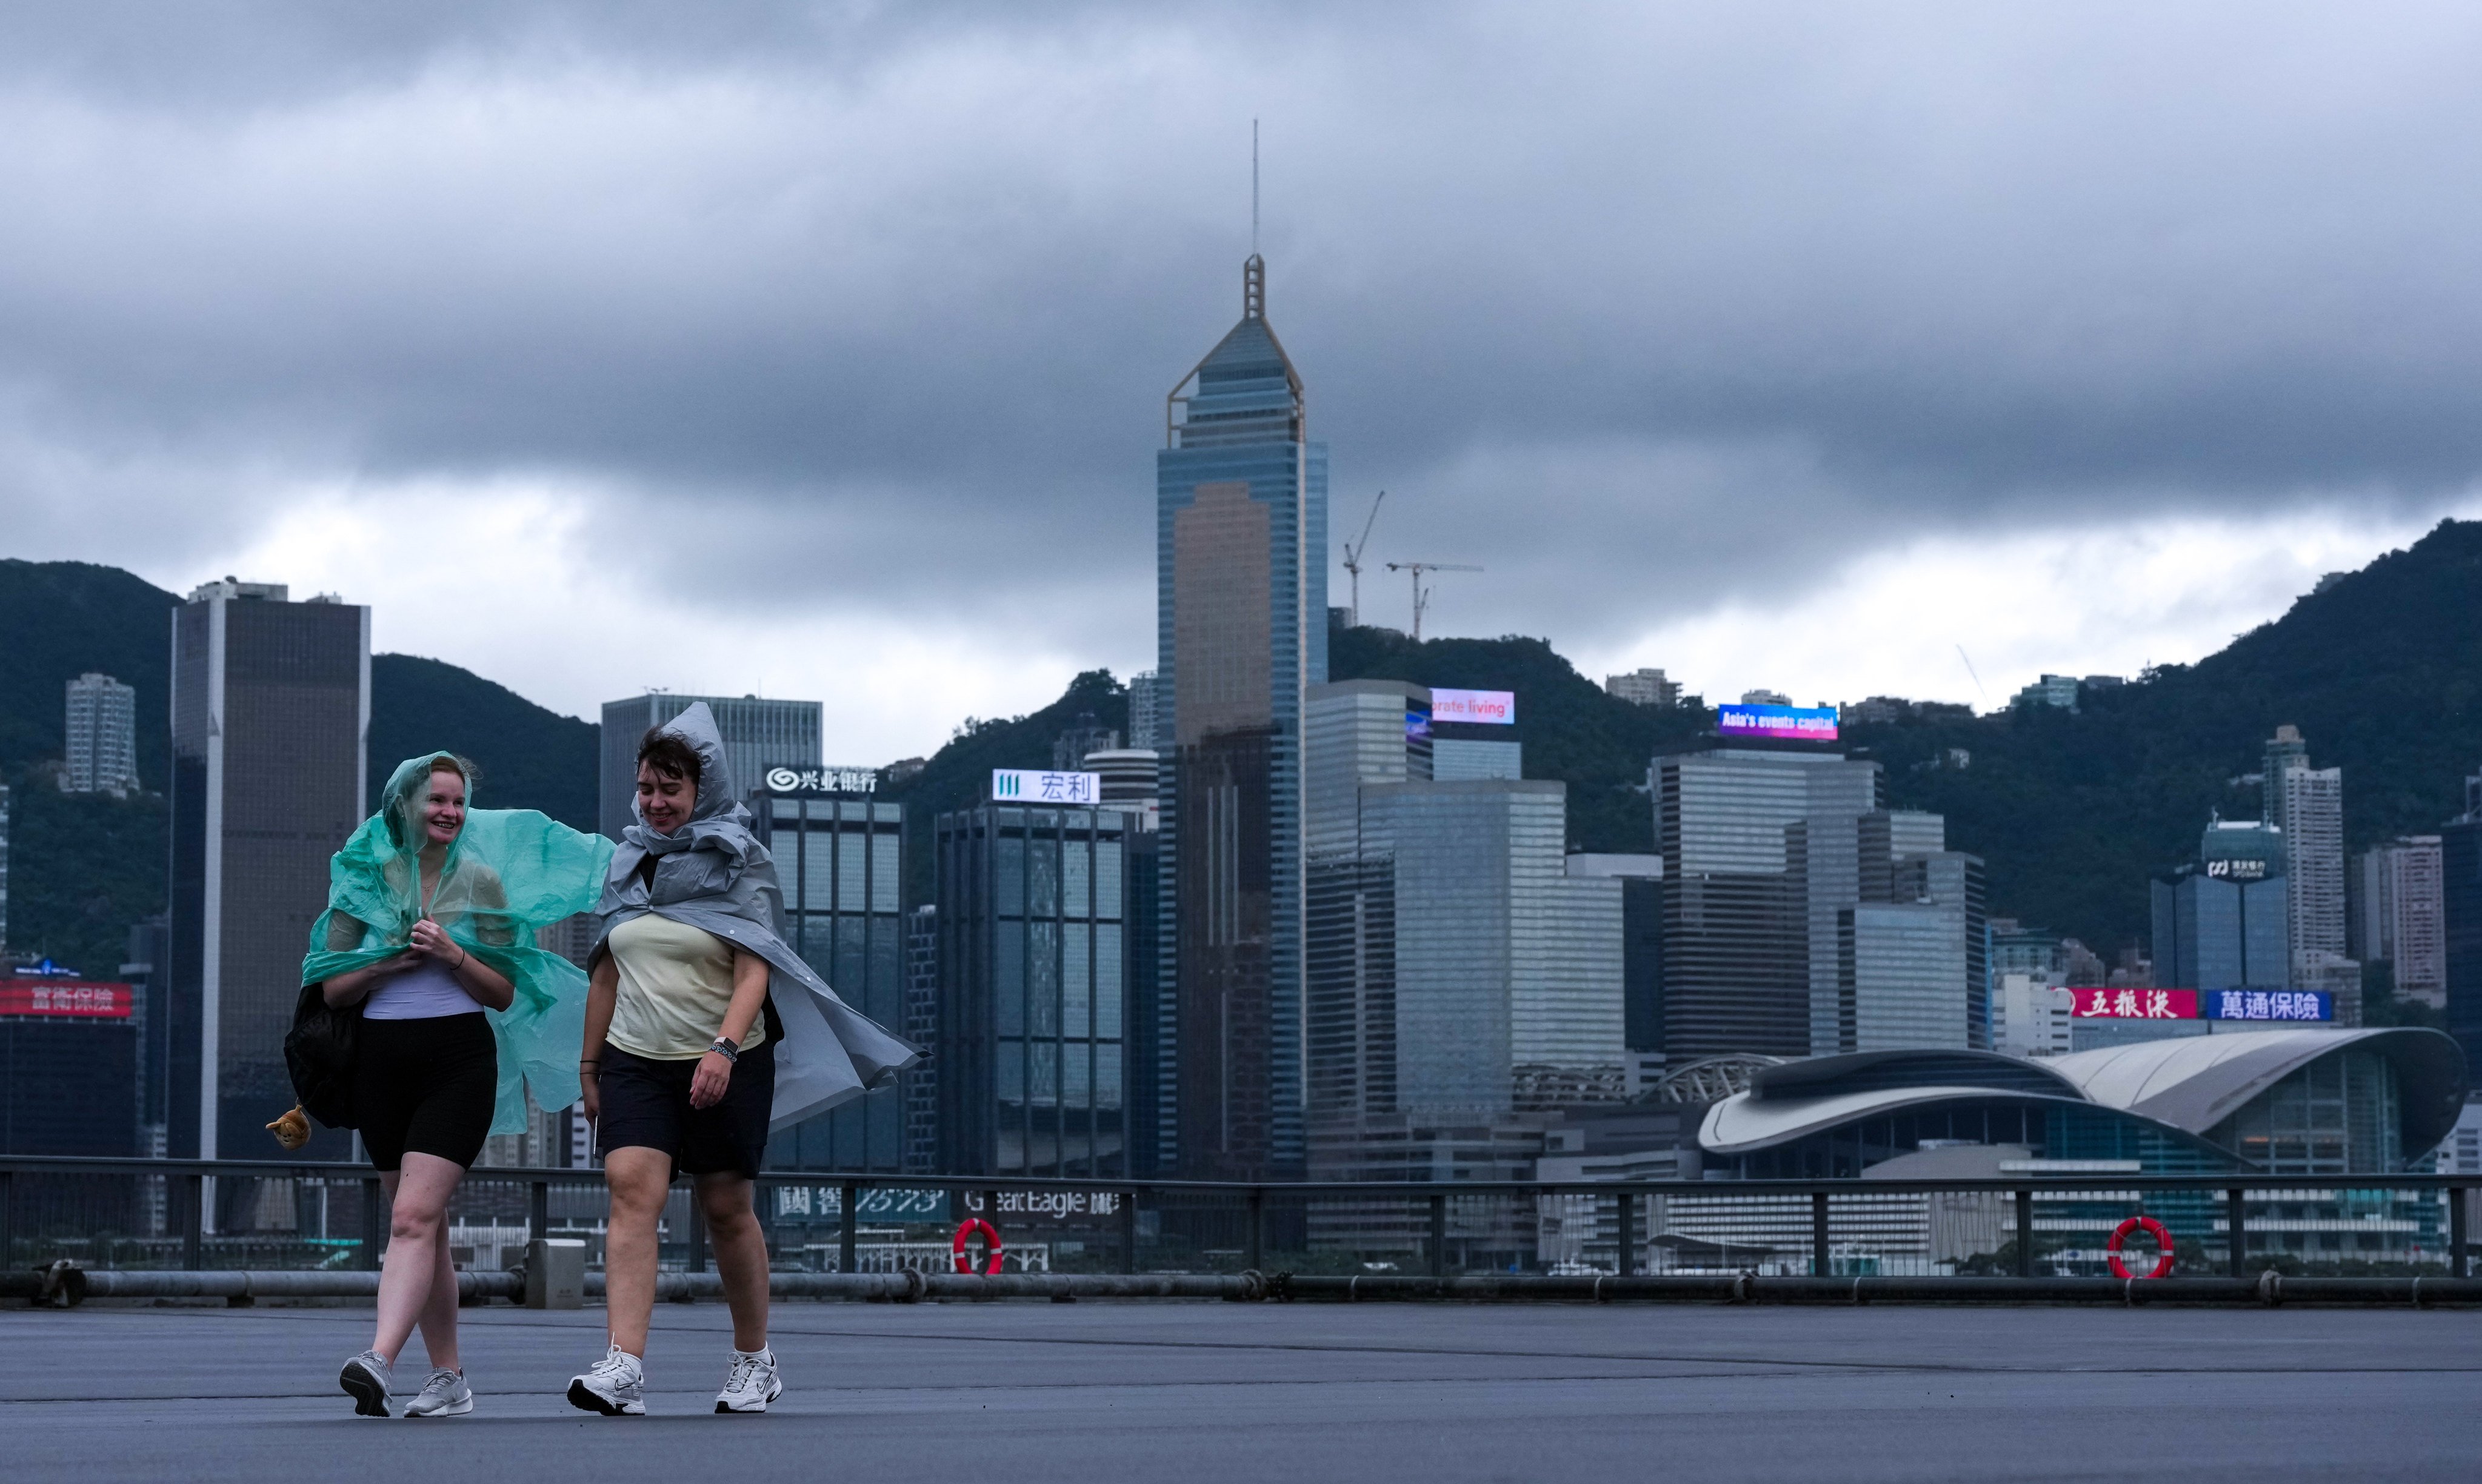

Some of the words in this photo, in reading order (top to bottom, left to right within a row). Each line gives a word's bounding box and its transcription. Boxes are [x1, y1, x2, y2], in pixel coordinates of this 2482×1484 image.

[1468, 699, 1505, 717] living
[1723, 711, 1756, 727] Asia's
[1758, 715, 1795, 730] events
[1797, 716, 1834, 733] capital
[800, 770, 878, 793] 兴业银行
[1041, 773, 1090, 802] 宏利
[2220, 990, 2320, 1020] 萬通保險
[1027, 1191, 1087, 1219] Eagle
